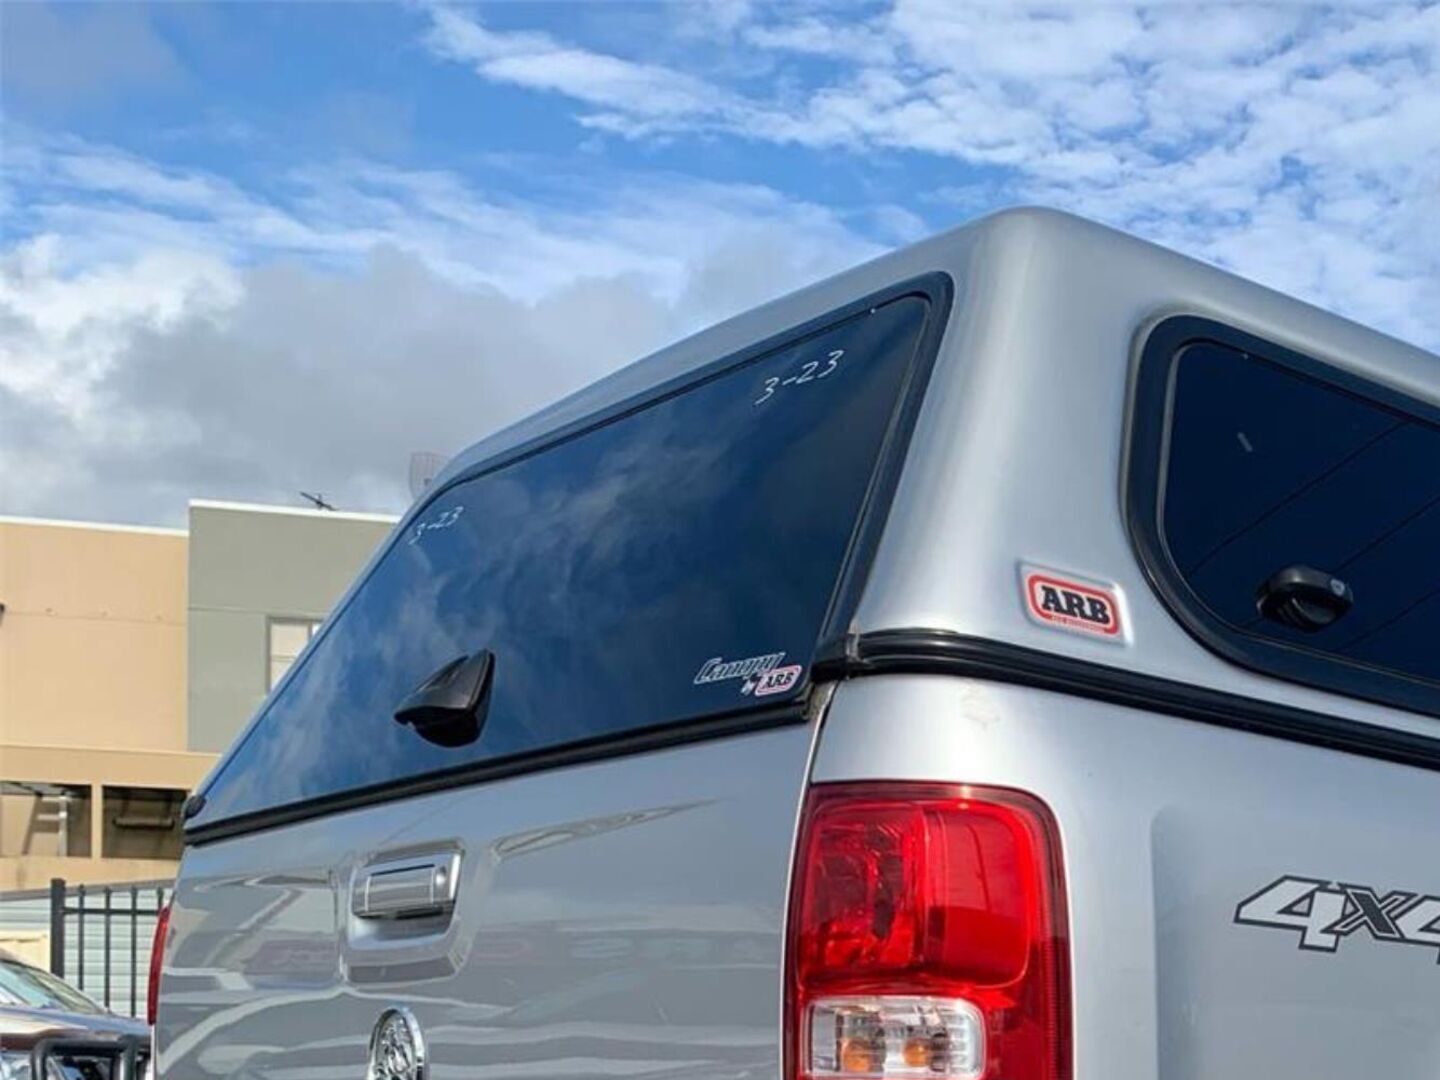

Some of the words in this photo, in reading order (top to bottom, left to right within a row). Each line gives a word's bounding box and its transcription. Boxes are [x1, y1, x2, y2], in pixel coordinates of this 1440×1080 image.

[753, 349, 845, 405] 3-23
[1041, 585, 1111, 624] ARB
[693, 652, 787, 685] Canopy
